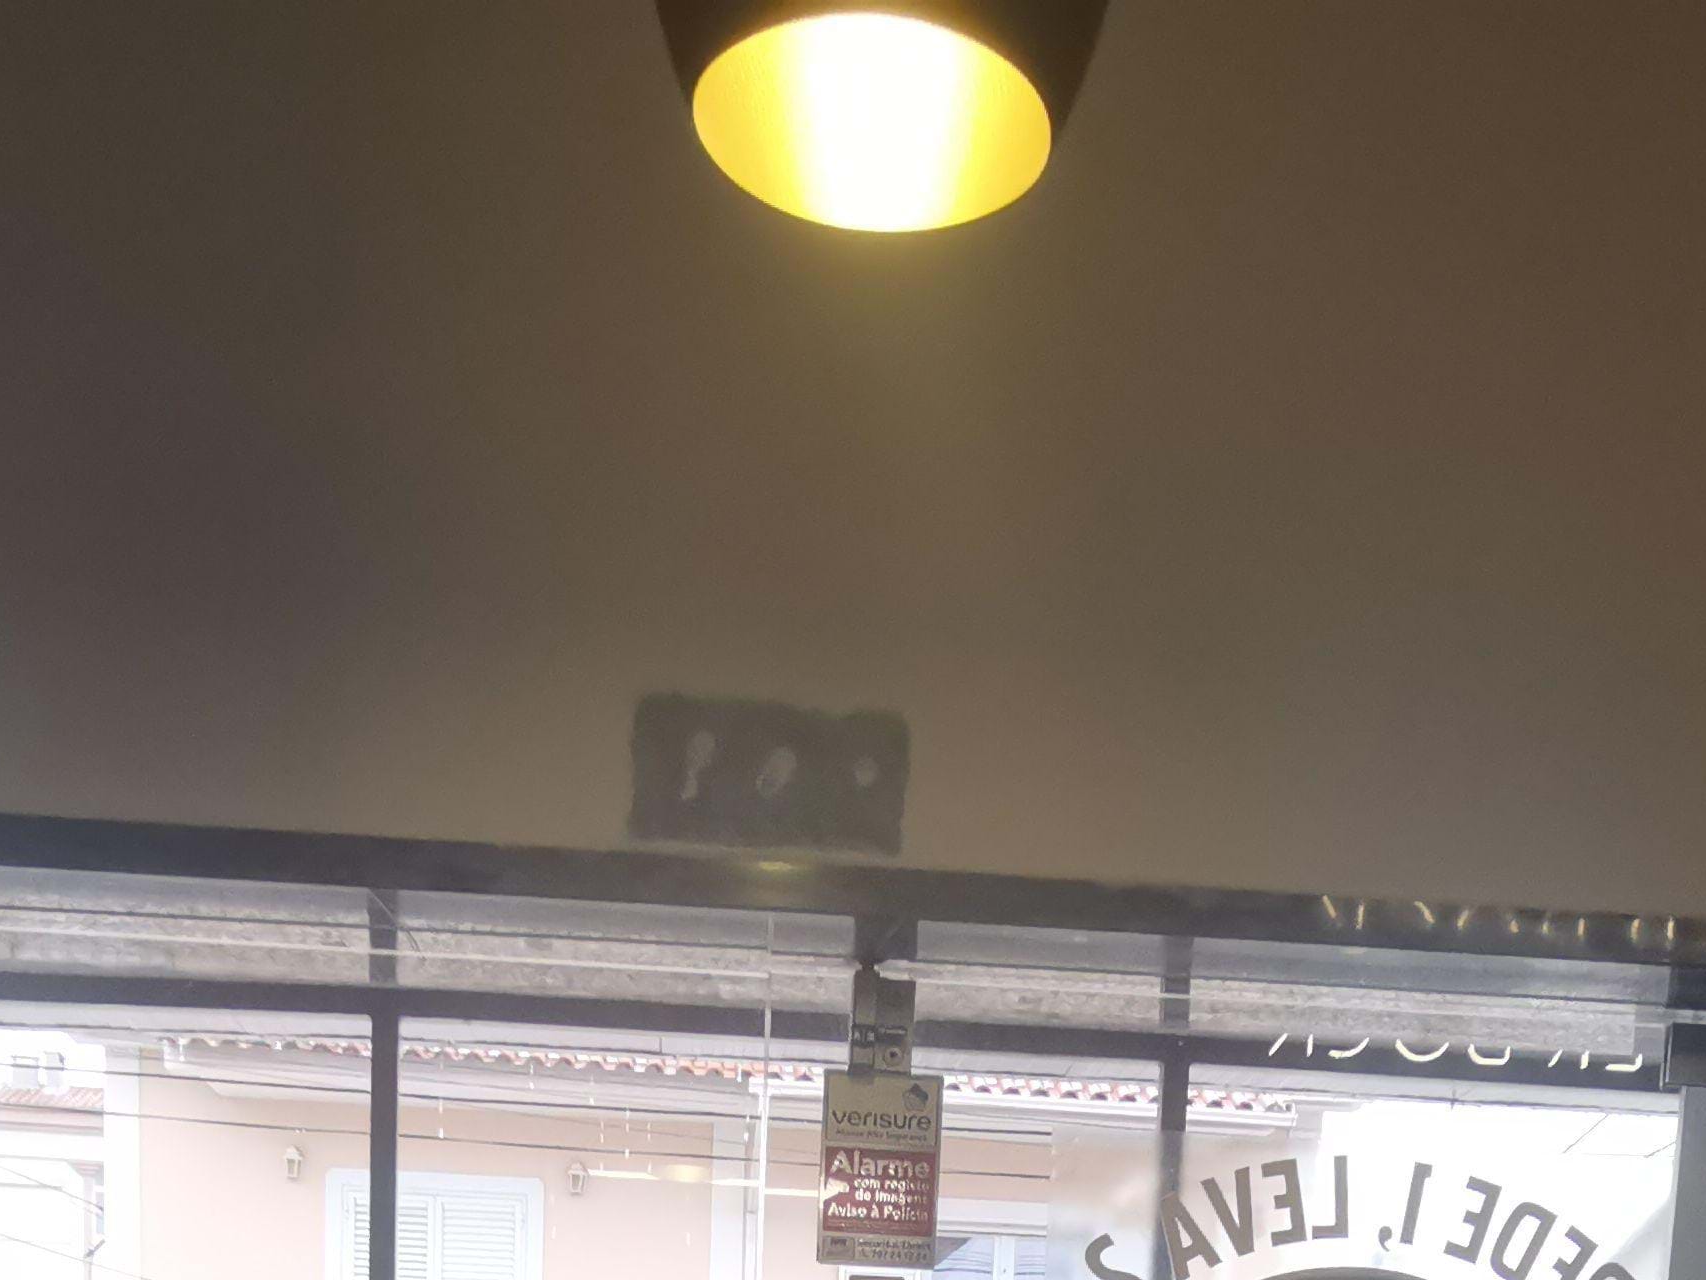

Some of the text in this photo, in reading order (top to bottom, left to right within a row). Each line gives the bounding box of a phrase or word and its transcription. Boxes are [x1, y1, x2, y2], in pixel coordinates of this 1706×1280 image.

[832, 1110, 932, 1130] verisure
[830, 1150, 930, 1179] Alarme
[854, 1178, 881, 1190] com
[827, 1202, 868, 1218] Aviso
